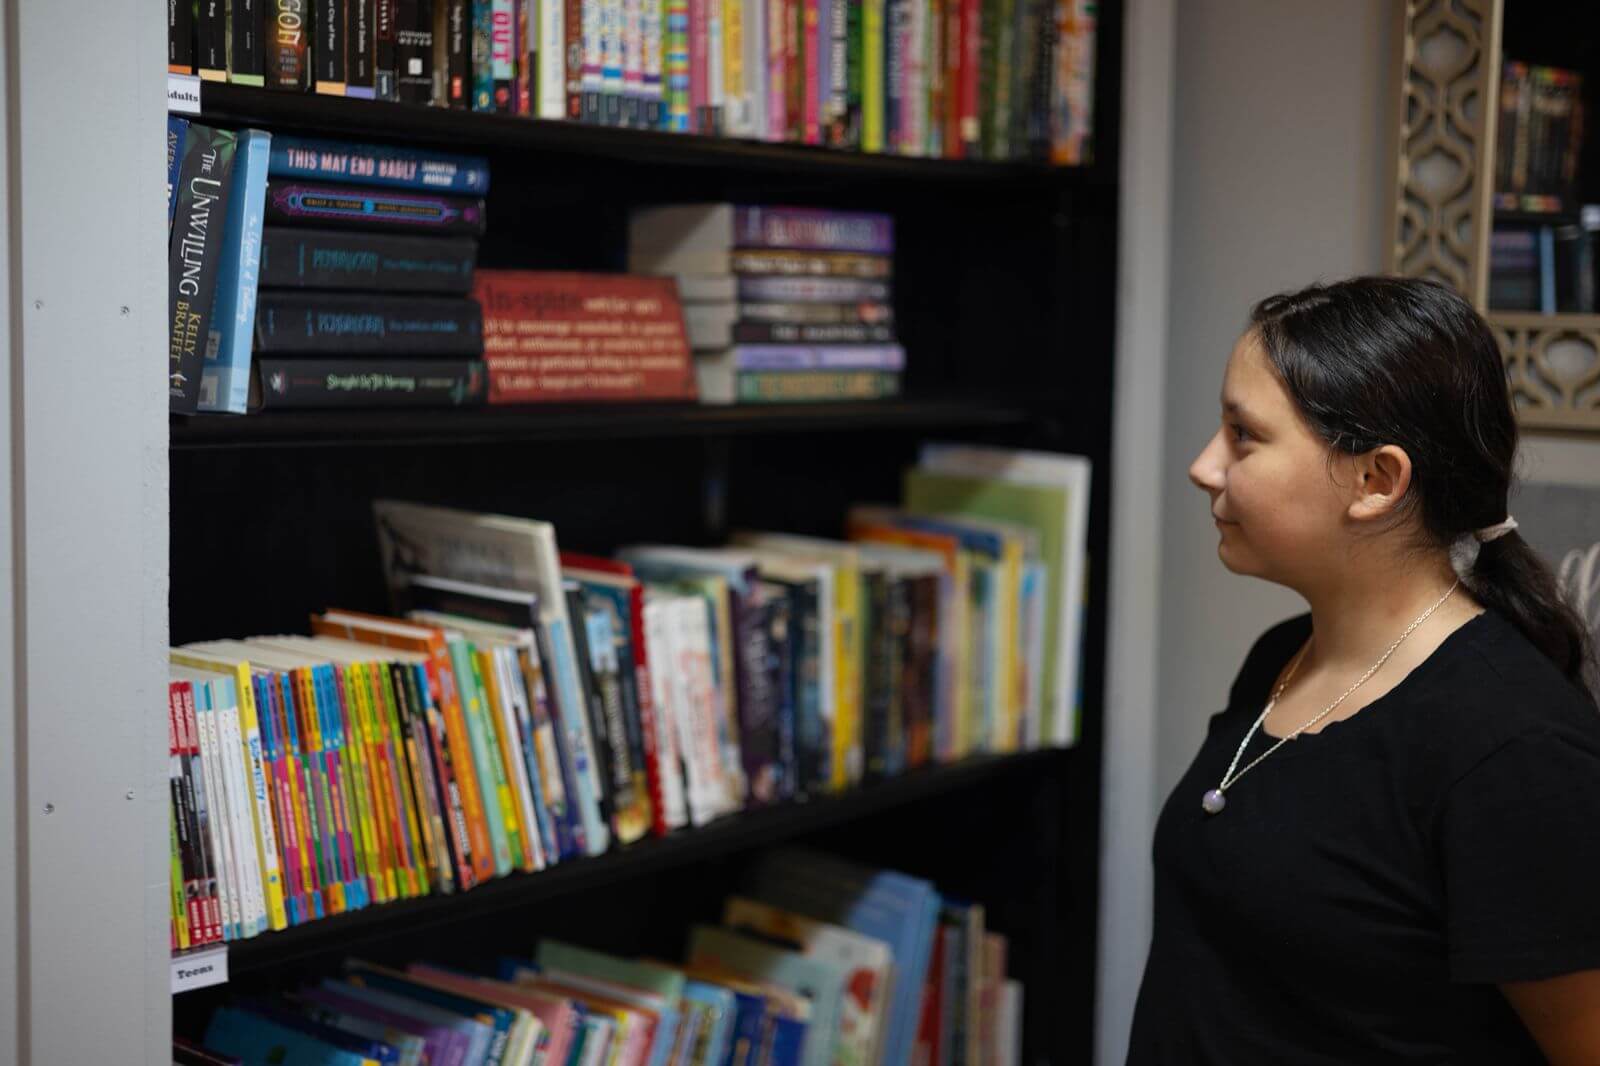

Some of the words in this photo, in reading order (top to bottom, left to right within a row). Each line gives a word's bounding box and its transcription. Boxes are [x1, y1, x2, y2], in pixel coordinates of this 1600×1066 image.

[493, 12, 512, 64] OUT
[287, 148, 317, 170] THIS
[320, 152, 348, 174] MAY
[350, 155, 375, 177] END
[378, 159, 417, 181] BADLY
[179, 177, 221, 296] UNWILLING
[170, 301, 190, 362] BRAFFET
[184, 312, 201, 356] KELLY
[177, 965, 213, 979] Teens
